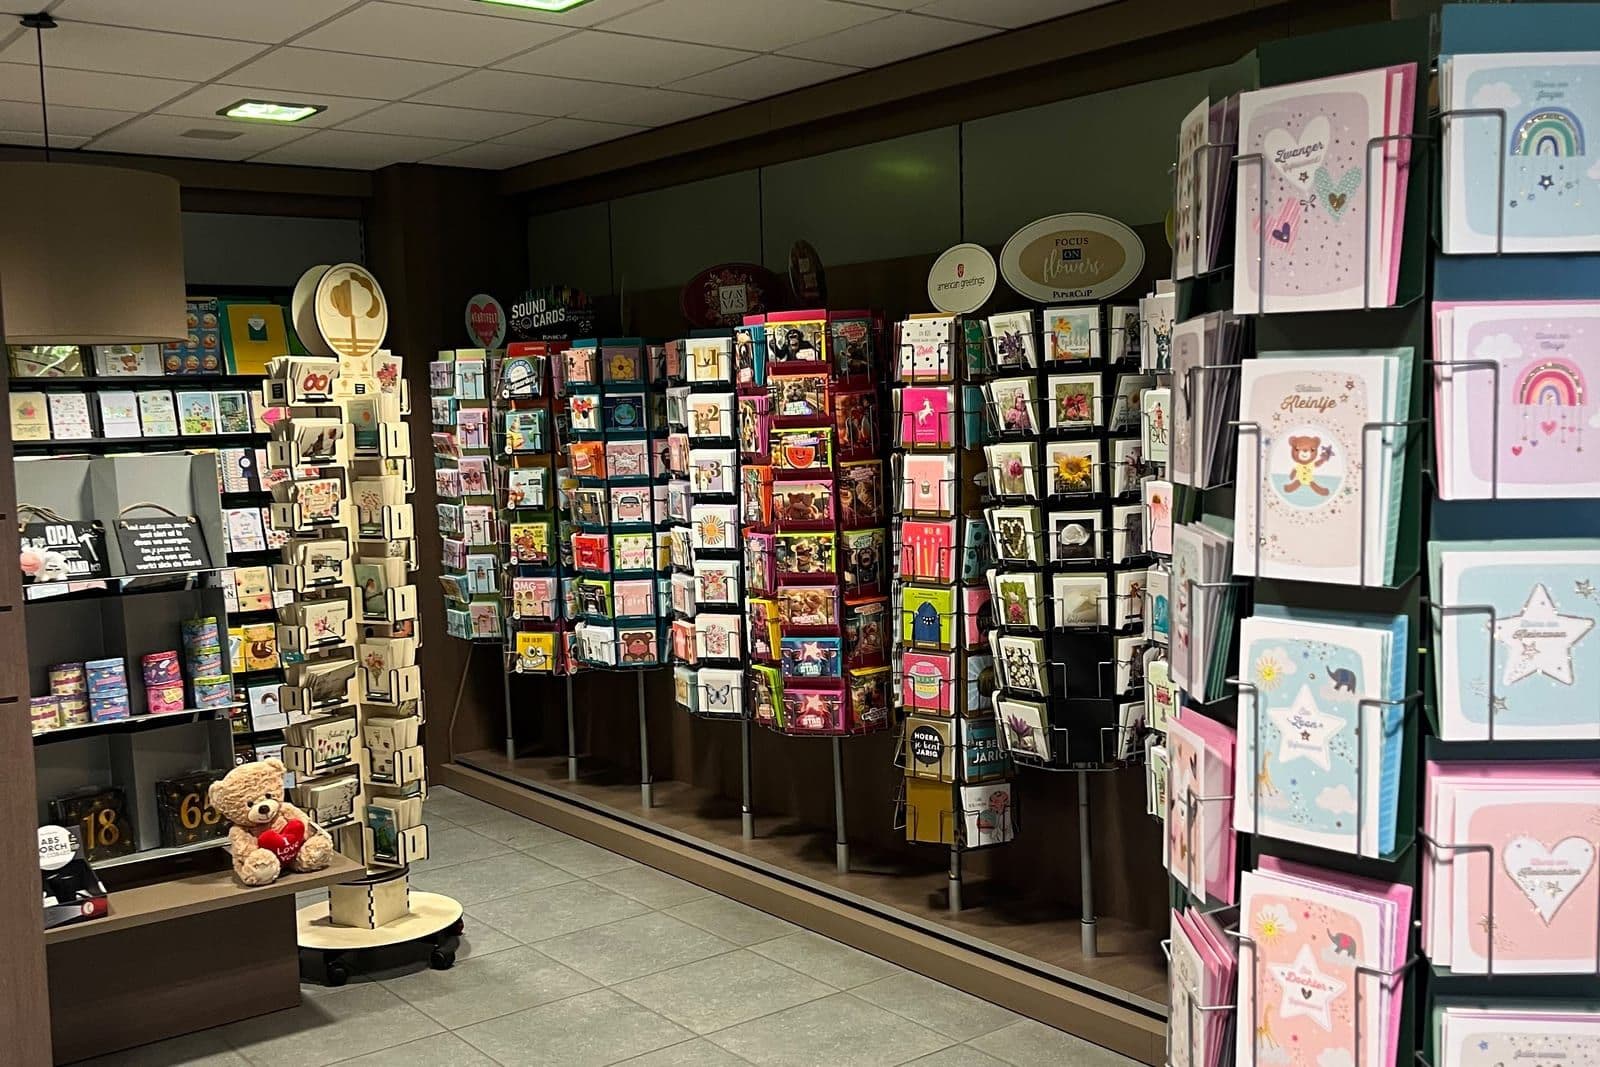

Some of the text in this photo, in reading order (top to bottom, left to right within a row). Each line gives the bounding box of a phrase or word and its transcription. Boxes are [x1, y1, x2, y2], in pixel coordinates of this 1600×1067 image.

[1274, 141, 1324, 163] Zwanger
[1055, 237, 1089, 247] FOCUS
[1063, 250, 1080, 259] ON
[1043, 249, 1103, 283] flowers
[937, 276, 985, 291] american greetings
[511, 298, 546, 319] SOUND
[533, 307, 566, 328] CARDS
[707, 404, 719, 422] 2
[1280, 395, 1338, 414] Kleintje
[709, 460, 721, 478] 3
[45, 524, 79, 546] OPA
[513, 580, 537, 591] OMG
[914, 731, 940, 742] HOERA
[923, 741, 941, 750] bent
[916, 749, 939, 758] JARIG
[83, 808, 120, 850] 18
[39, 843, 68, 854] ORCH
[282, 836, 290, 846] I
[1285, 971, 1328, 991] Dochter
